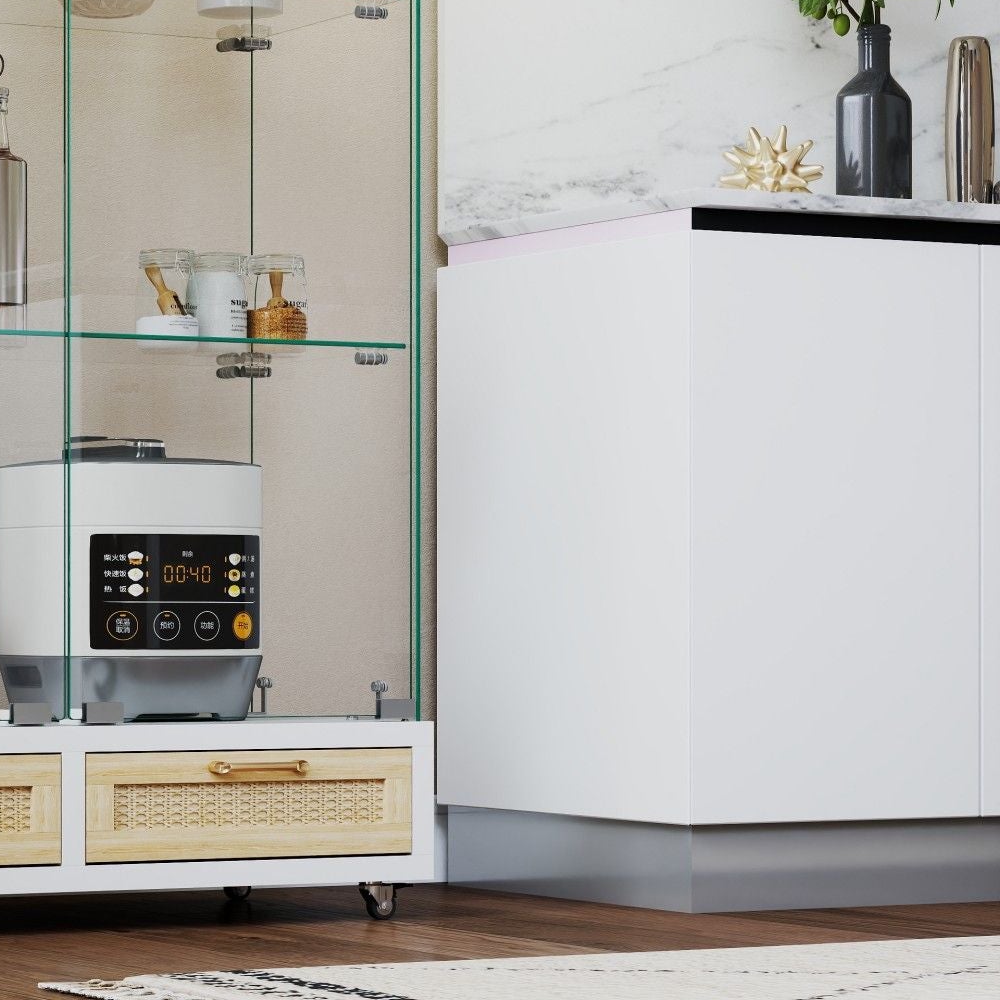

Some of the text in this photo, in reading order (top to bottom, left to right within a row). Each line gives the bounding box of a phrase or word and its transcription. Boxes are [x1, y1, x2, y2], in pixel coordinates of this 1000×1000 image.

[103, 570, 126, 578] 快速饭
[164, 565, 211, 583] 00:40
[200, 621, 214, 630] 功能
